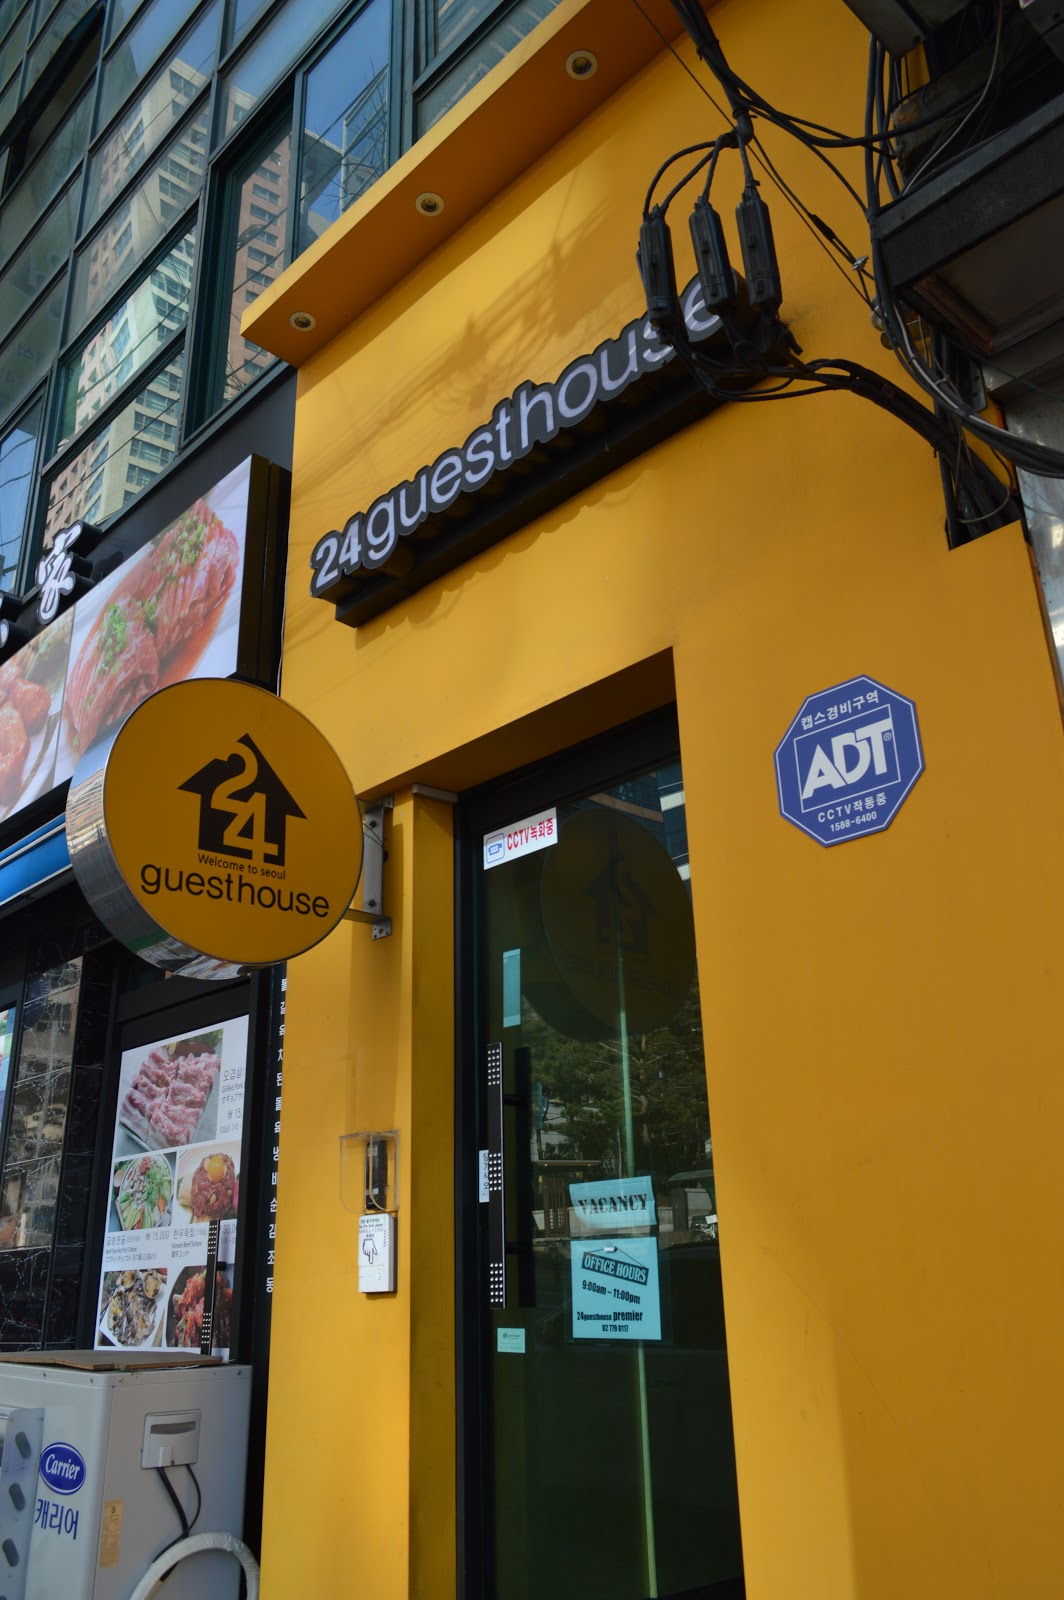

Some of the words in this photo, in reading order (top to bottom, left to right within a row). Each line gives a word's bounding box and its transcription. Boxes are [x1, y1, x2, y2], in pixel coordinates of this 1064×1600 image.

[314, 276, 735, 589] 24guesthouse
[801, 690, 879, 731] 캡스경비구역
[801, 717, 893, 800] ADT
[817, 792, 887, 823] CCTV작동중
[829, 811, 878, 832] 1588-6400
[507, 817, 553, 851] CCTV녹화중
[197, 853, 245, 873] Welcome
[247, 864, 258, 875] to
[260, 868, 286, 880] seoul
[140, 863, 330, 918] guesthouse
[578, 1193, 648, 1215] VACANCY
[584, 1254, 615, 1275] OFFICE
[616, 1263, 647, 1283] HOURS
[582, 1279, 607, 1295] 9:00am
[613, 1288, 641, 1304] 11:00pm
[576, 1311, 612, 1321] 24guesthouse
[613, 1310, 643, 1322] premier
[45, 1453, 80, 1480] Carrier
[34, 1498, 79, 1540] 캐리어
